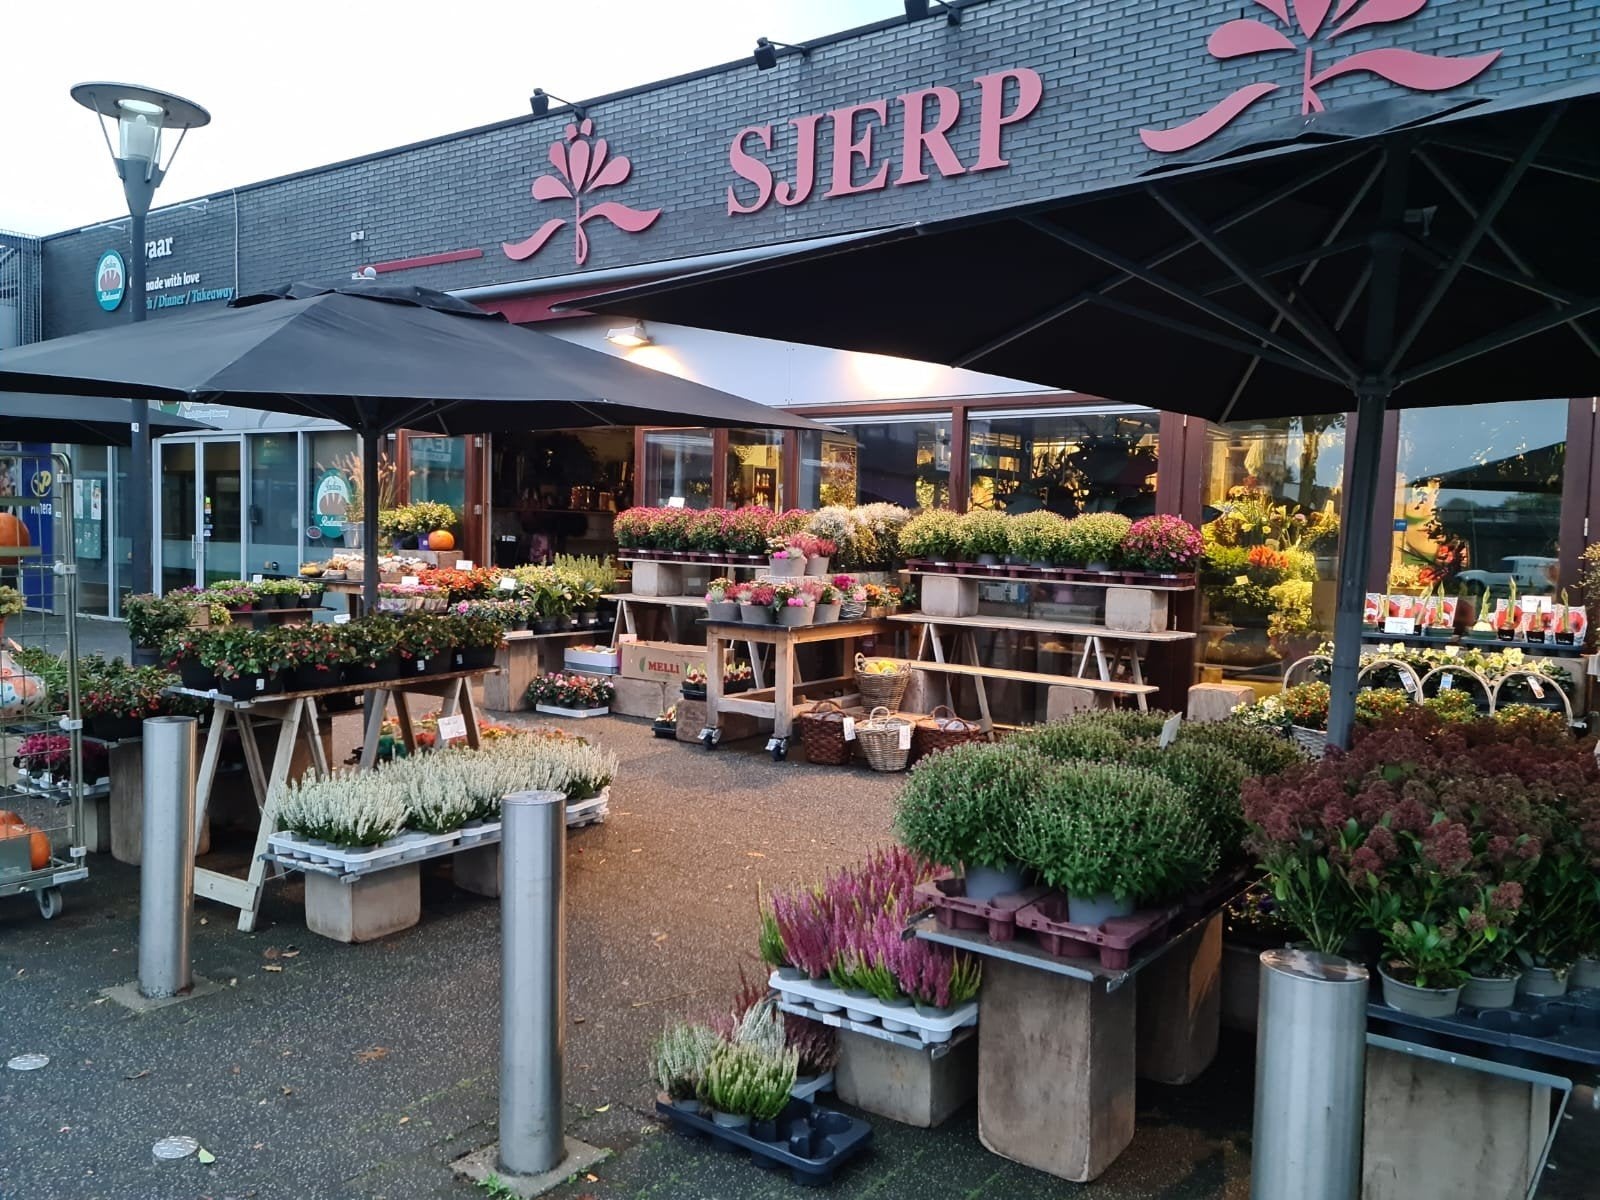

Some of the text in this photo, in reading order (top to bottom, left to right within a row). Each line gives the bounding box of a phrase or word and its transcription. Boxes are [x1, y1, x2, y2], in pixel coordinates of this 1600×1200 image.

[728, 67, 1044, 217] SJERP
[163, 273, 182, 288] with
[183, 272, 200, 285] love
[158, 293, 185, 308] Dinner
[191, 286, 234, 303] Takeaway
